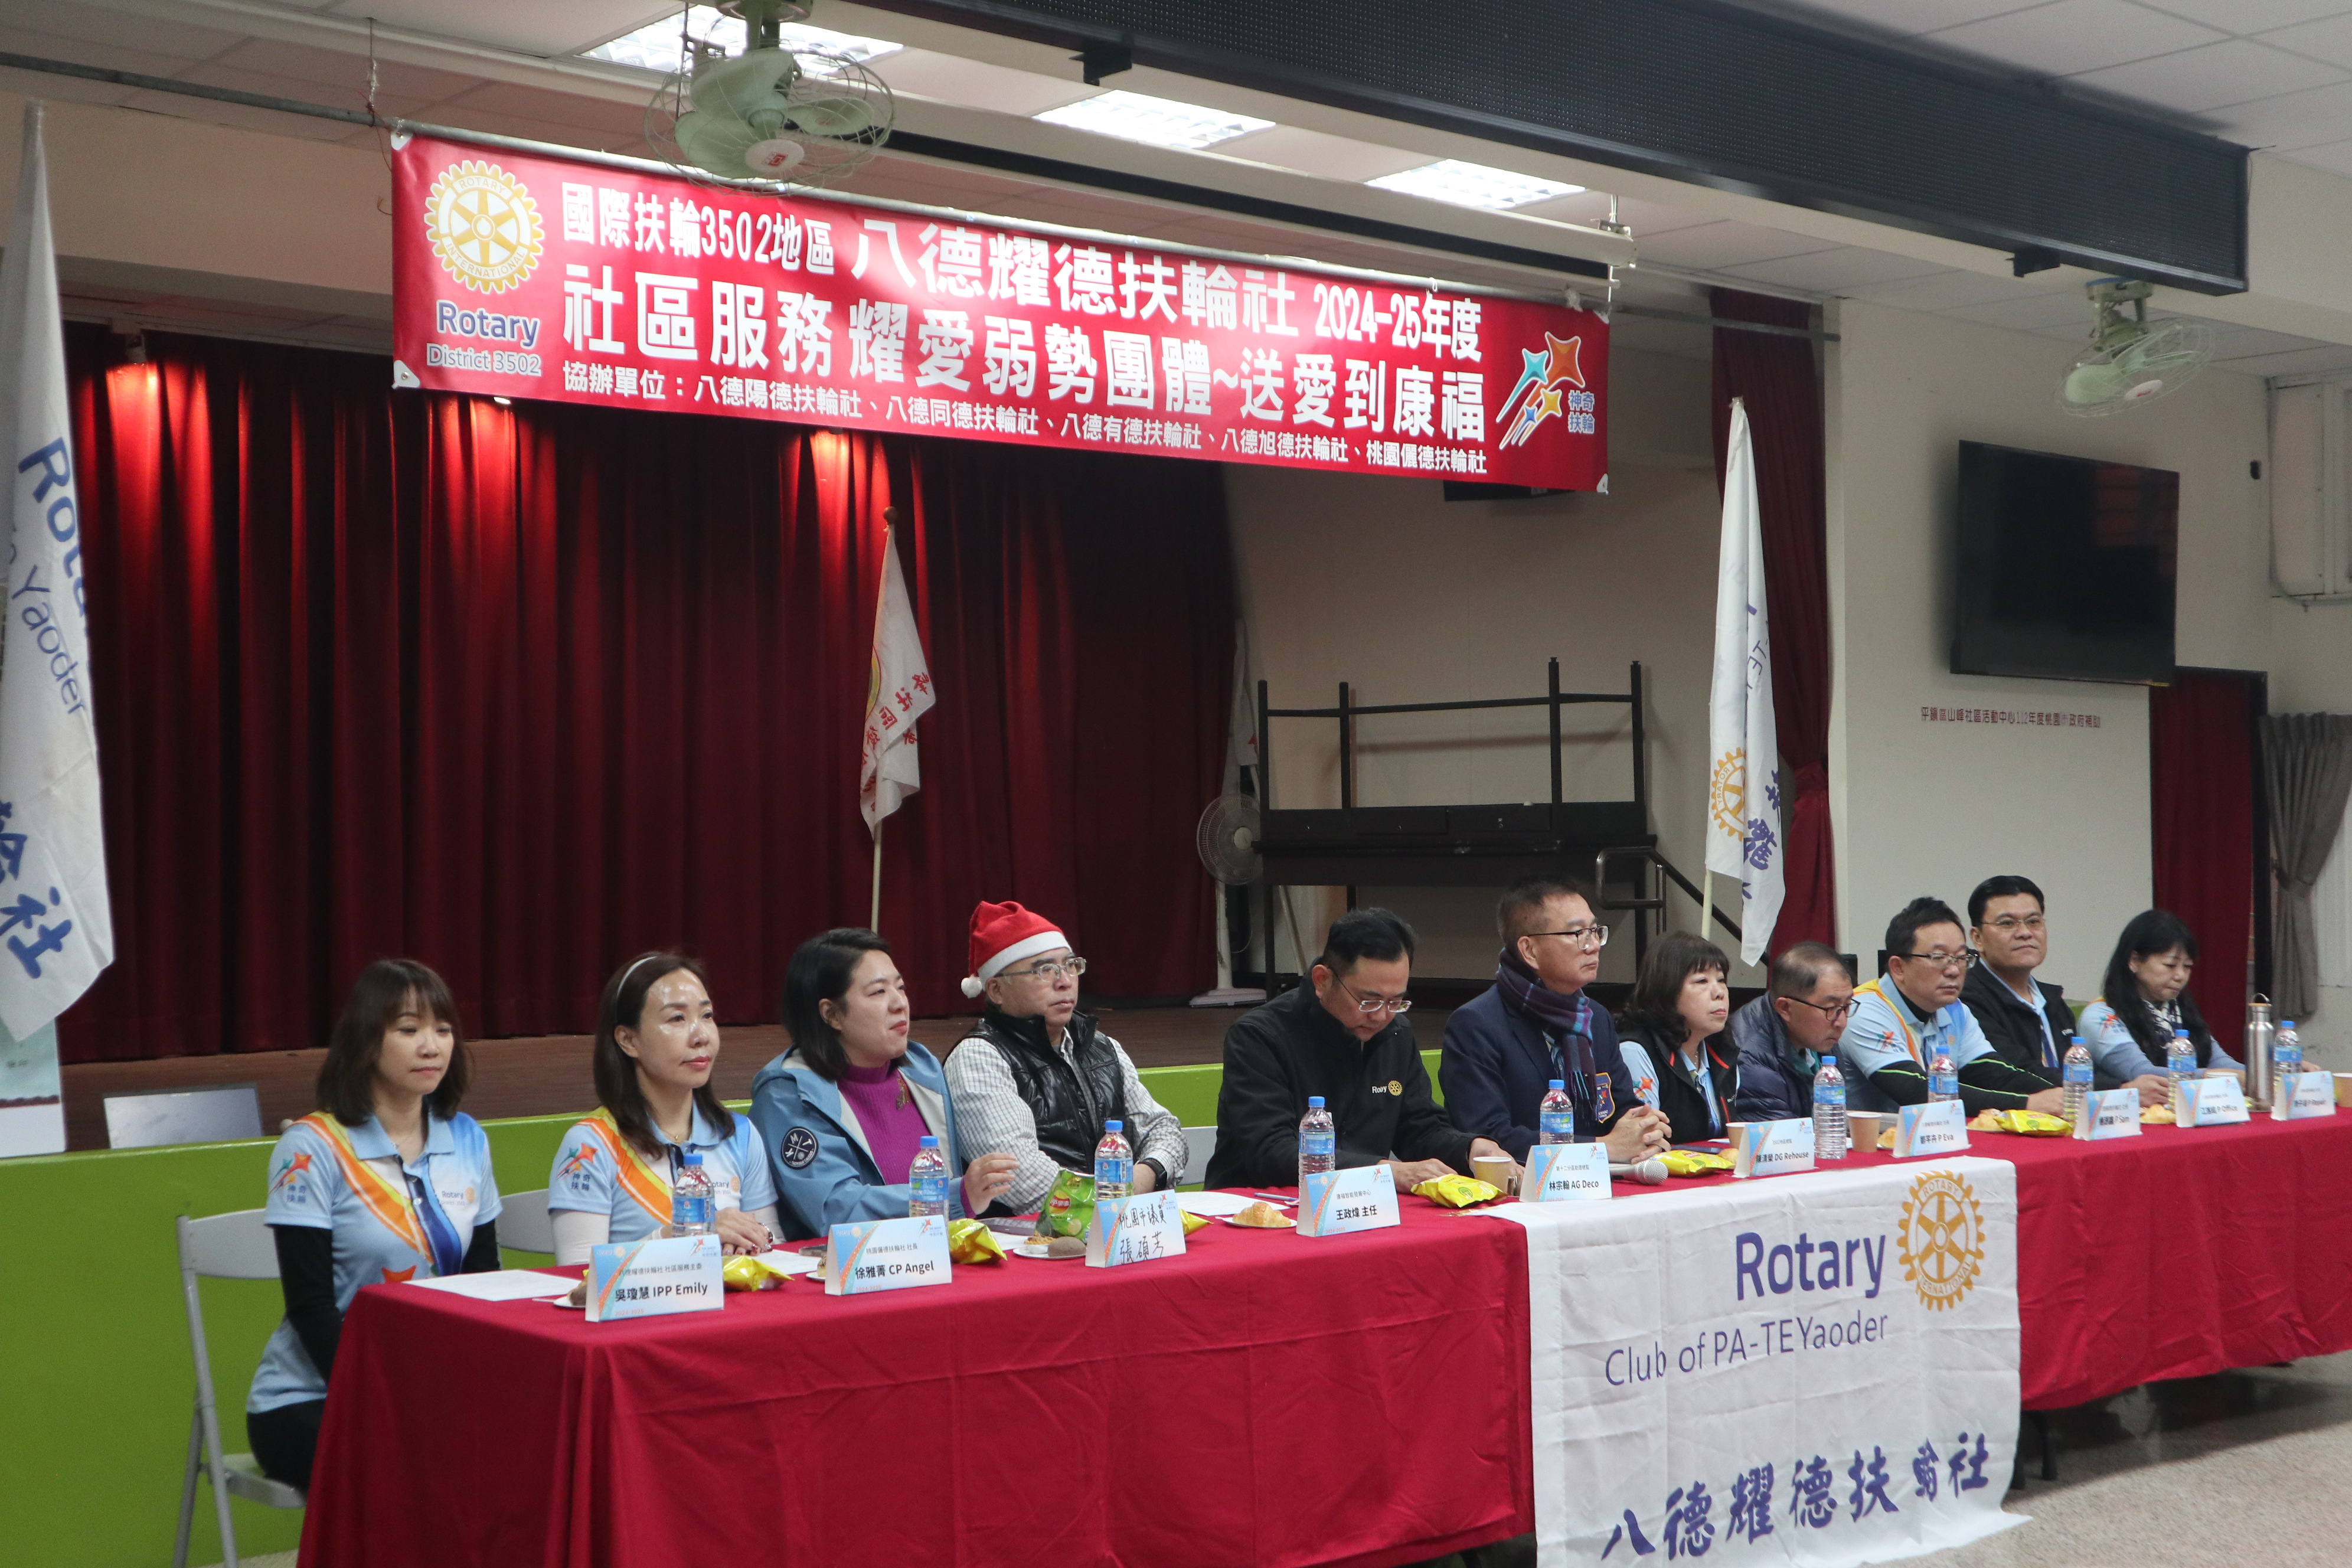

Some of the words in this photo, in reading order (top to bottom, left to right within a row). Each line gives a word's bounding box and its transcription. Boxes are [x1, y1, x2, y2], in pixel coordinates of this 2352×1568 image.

[459, 178, 506, 194] ROTARY
[444, 241, 527, 278] INTERNATIONAL
[562, 182, 834, 275] 國際扶輪3502地區
[851, 219, 1298, 337] 八德耀德扶輪社
[1314, 283, 1482, 362] 2024-25年度
[438, 301, 539, 347] Rotary
[427, 344, 491, 370] District
[494, 351, 541, 375] 3502
[1569, 390, 1595, 411] 神奇
[1568, 411, 1595, 434] 扶輪
[1784, 1151, 1809, 1159] Rehouse
[442, 1190, 463, 1200] Rotary
[1571, 1180, 1580, 1189] AG
[1582, 1180, 1599, 1188] Deco
[1362, 1205, 1378, 1217] 主任
[889, 1264, 902, 1275] CP
[906, 1260, 935, 1275] Angel
[1736, 1231, 1887, 1301] Rotary
[653, 1285, 672, 1297] IPP
[676, 1282, 708, 1296] Emily
[1605, 1340, 1667, 1386] Club
[1679, 1331, 1706, 1373] of
